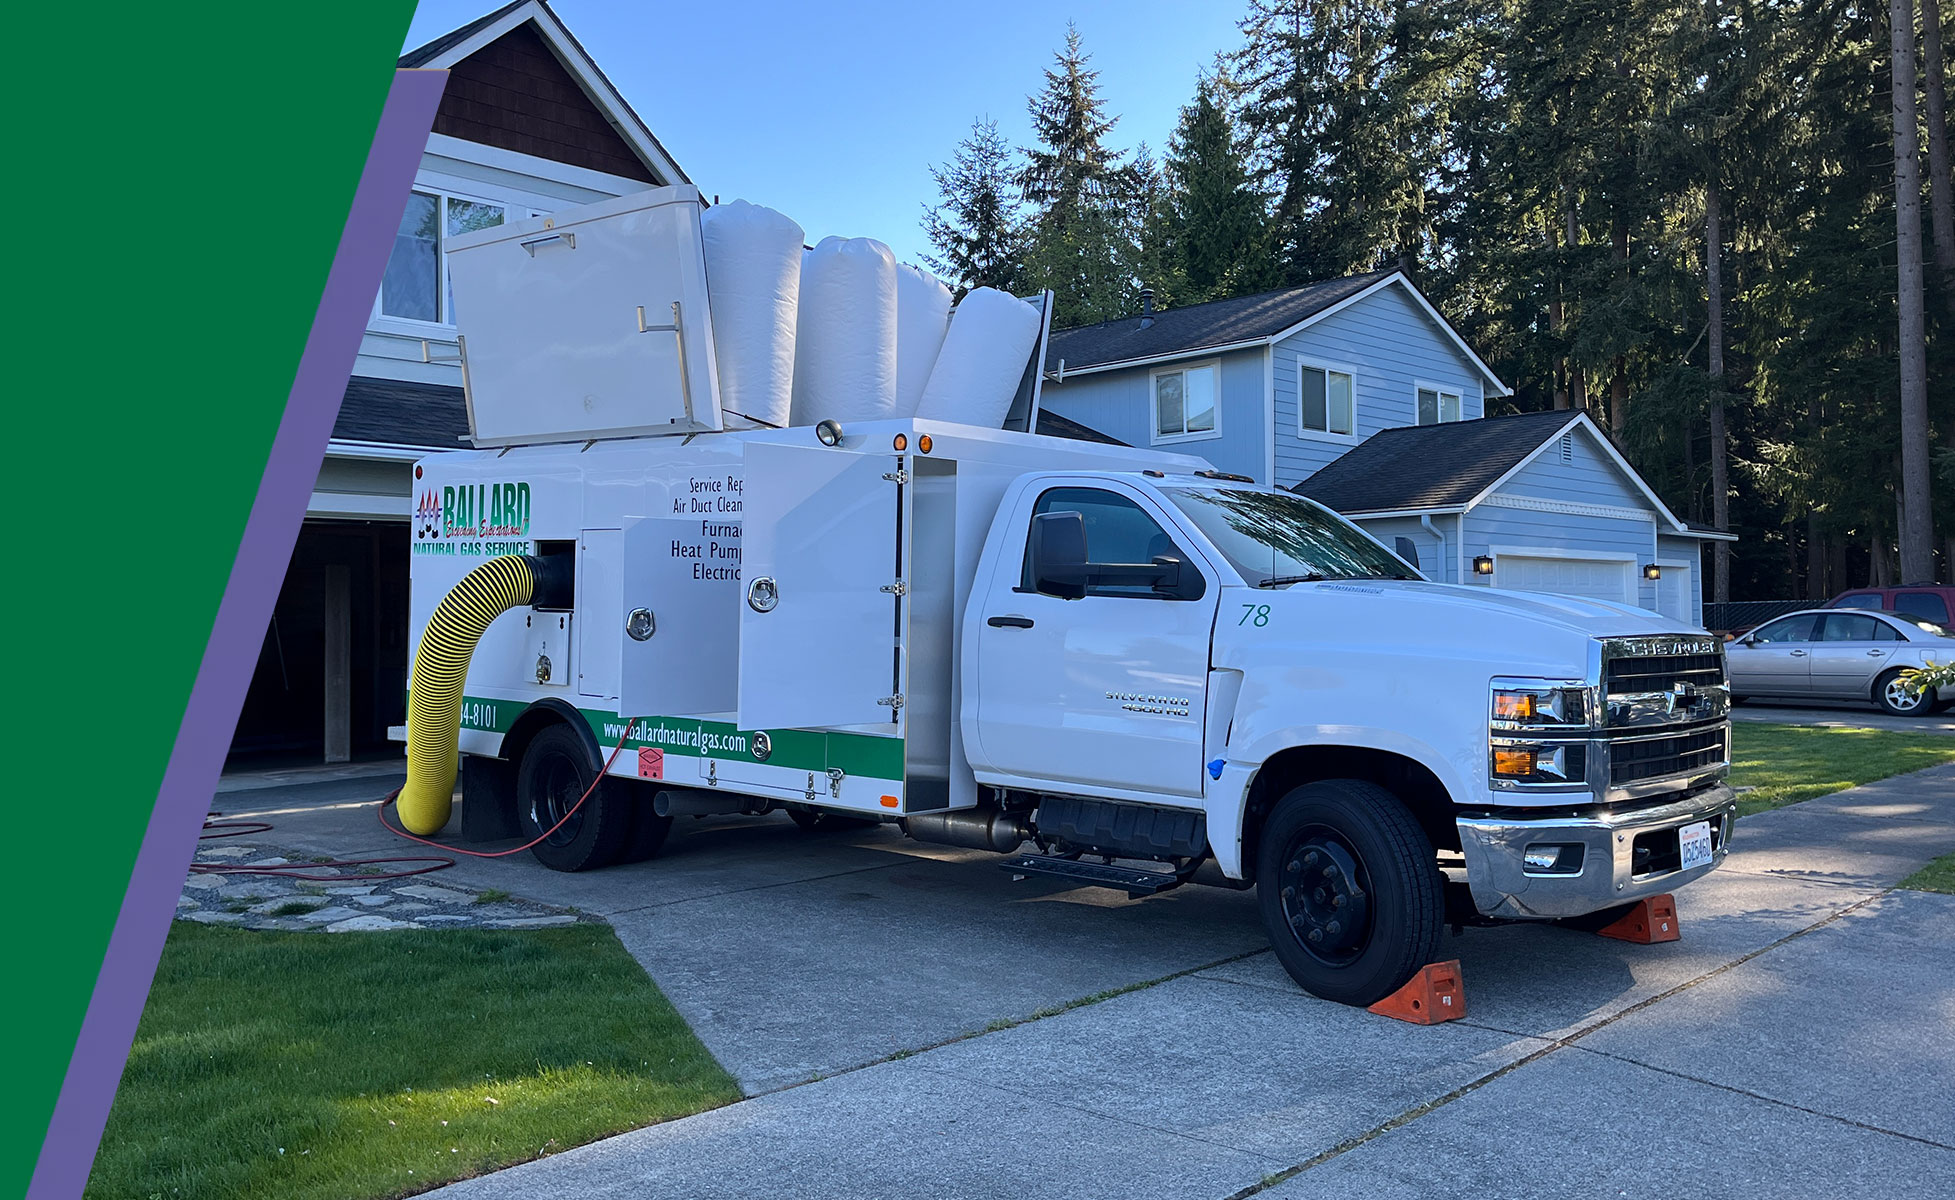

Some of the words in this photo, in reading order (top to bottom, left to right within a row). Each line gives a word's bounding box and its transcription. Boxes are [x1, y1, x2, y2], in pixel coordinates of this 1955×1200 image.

[689, 476, 722, 493] Service
[443, 482, 531, 539] BALLARD
[673, 498, 686, 513] Air
[691, 497, 712, 513] Duct
[717, 496, 743, 512] Clean
[413, 542, 457, 556] NATURAL
[460, 542, 481, 556] GAS
[485, 541, 530, 556] SERVICE
[671, 540, 702, 558] Heat
[693, 562, 741, 580] Electric
[1238, 604, 1271, 627] 78
[1631, 641, 1714, 657] CHEVROLET
[1105, 691, 1189, 706] SILVERADO
[1121, 703, 1163, 714] 4500
[1166, 706, 1189, 717] HD
[603, 719, 746, 755] www.ballardnaturalgas.com
